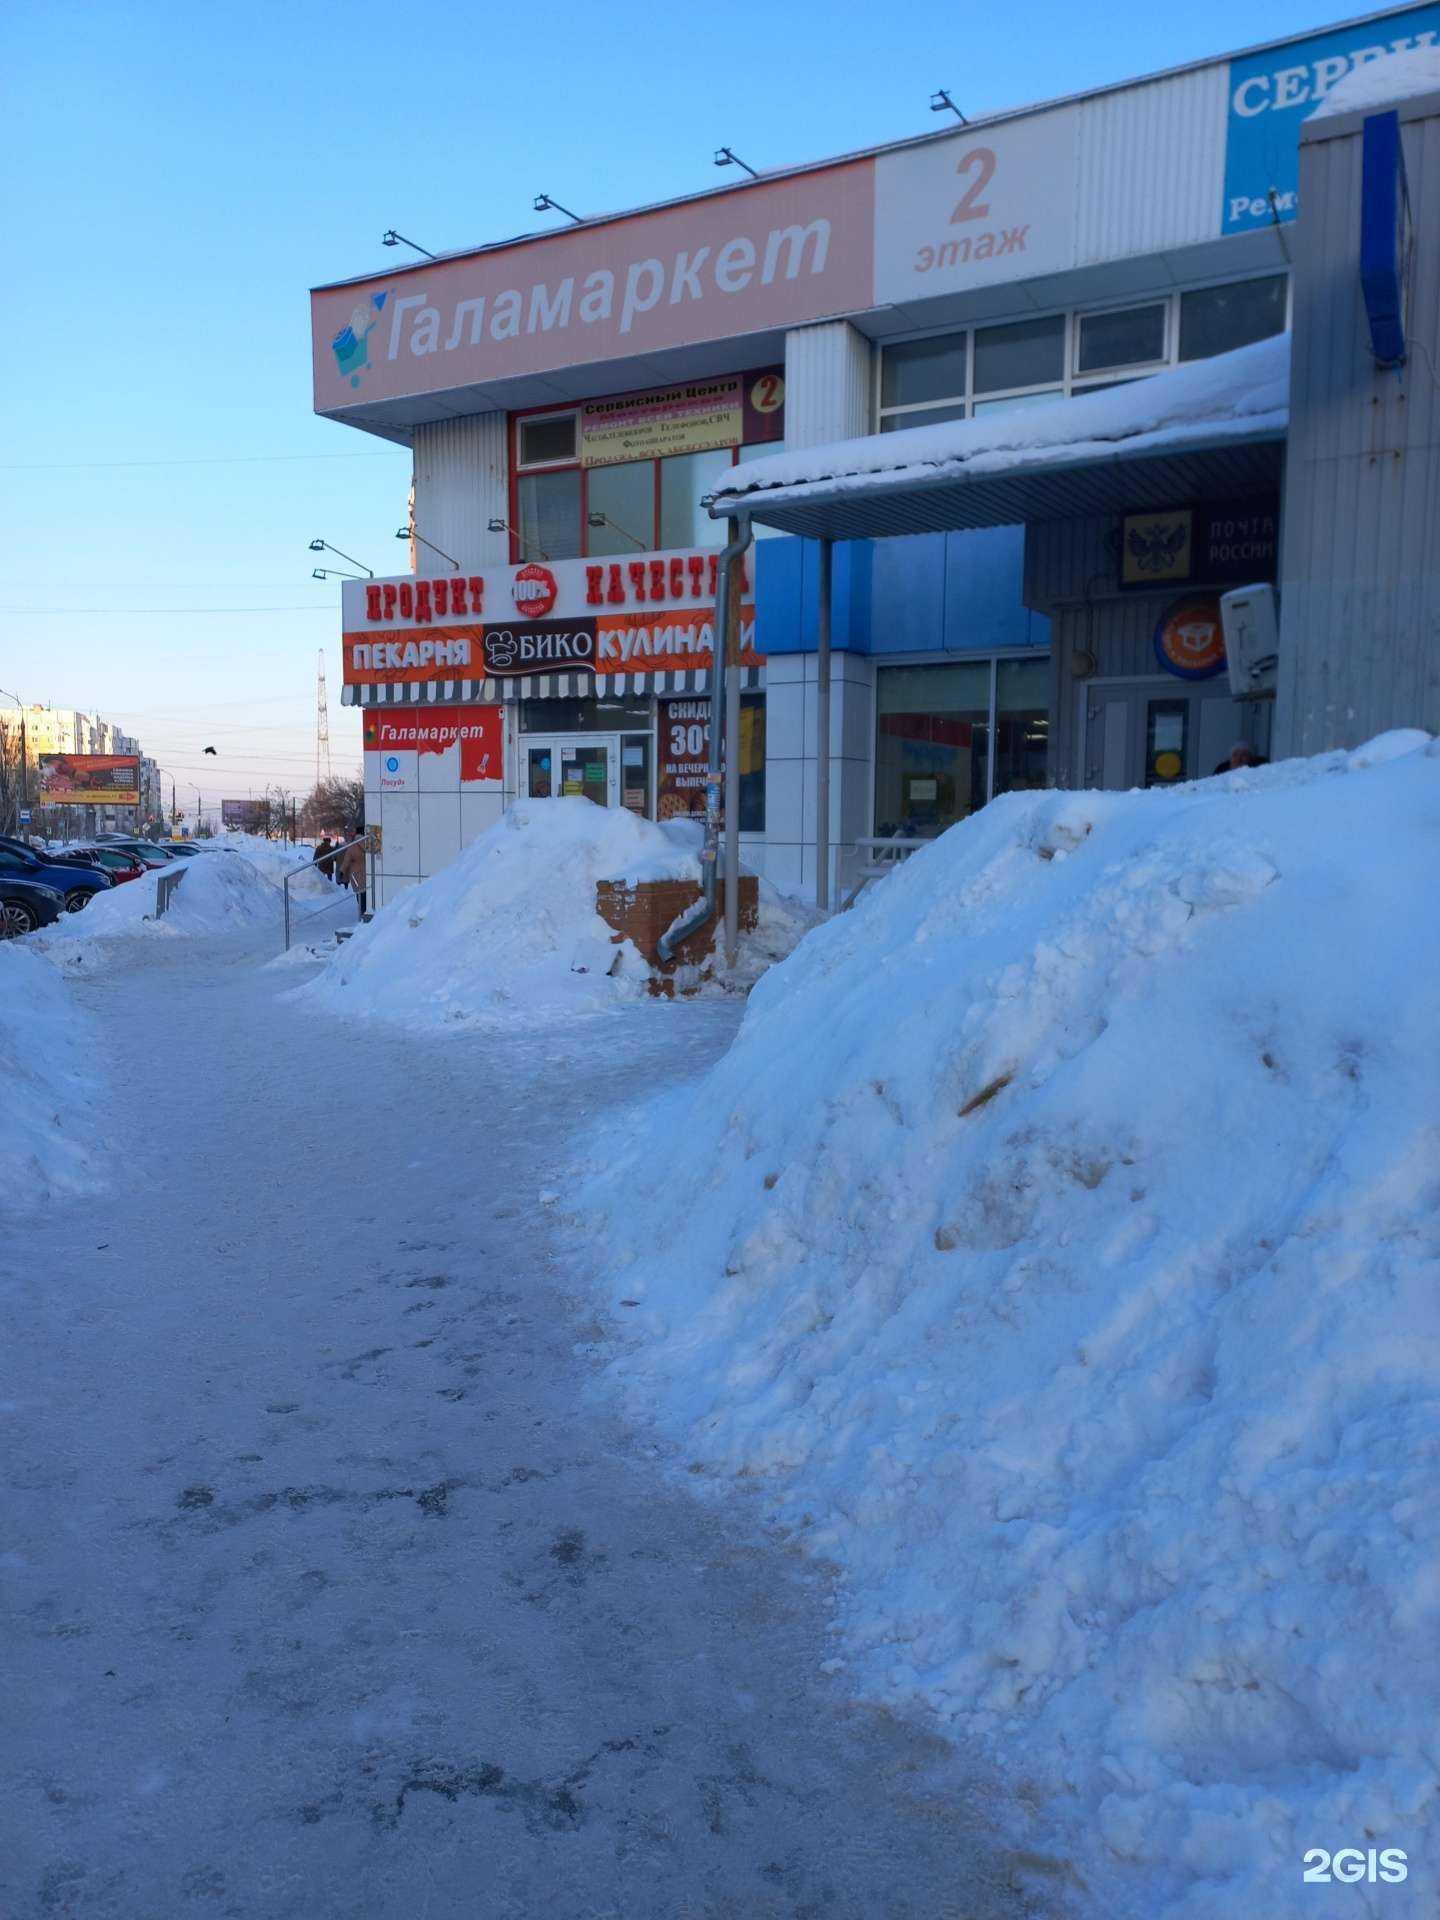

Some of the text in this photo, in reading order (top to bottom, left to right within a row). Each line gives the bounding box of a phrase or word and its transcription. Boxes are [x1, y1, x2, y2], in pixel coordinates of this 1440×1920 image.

[949, 148, 996, 225] 2
[1228, 191, 1298, 221] Рем
[913, 224, 1031, 272] этаж
[388, 218, 831, 360] Галамаркет
[686, 381, 738, 399] Центр
[760, 376, 778, 406] 2
[1210, 517, 1273, 538] ПОЧТА
[1210, 542, 1273, 561] РОССИИ
[367, 576, 484, 623] ПРОДУКТ
[353, 638, 470, 669] ПЕКАРНЯ
[519, 631, 592, 659] БИКО
[381, 725, 483, 743] Галамаркет
[671, 724, 726, 755] 30
